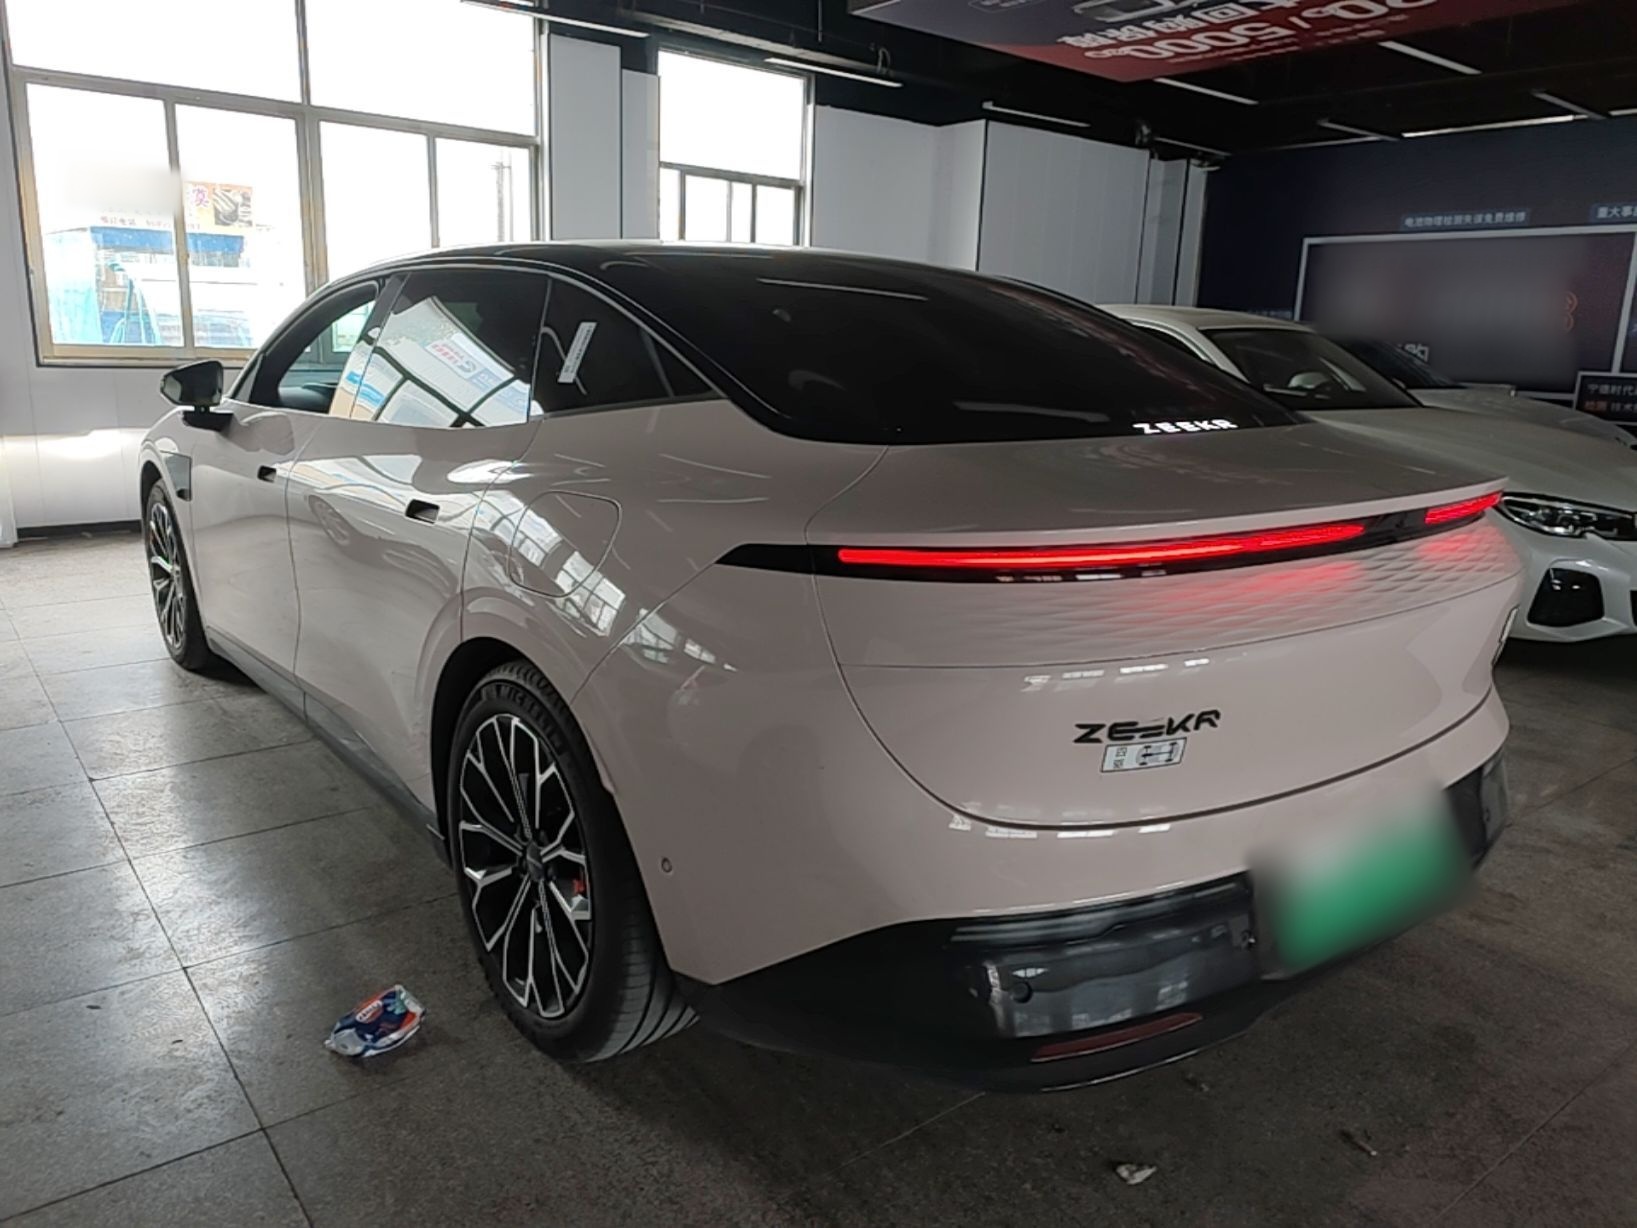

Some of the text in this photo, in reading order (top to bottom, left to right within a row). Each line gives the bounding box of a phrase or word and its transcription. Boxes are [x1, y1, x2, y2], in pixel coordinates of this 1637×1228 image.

[1586, 383, 1637, 397] 宁德时代
[1132, 419, 1239, 435] ZEEKR
[1073, 709, 1221, 744] ZEEKR
